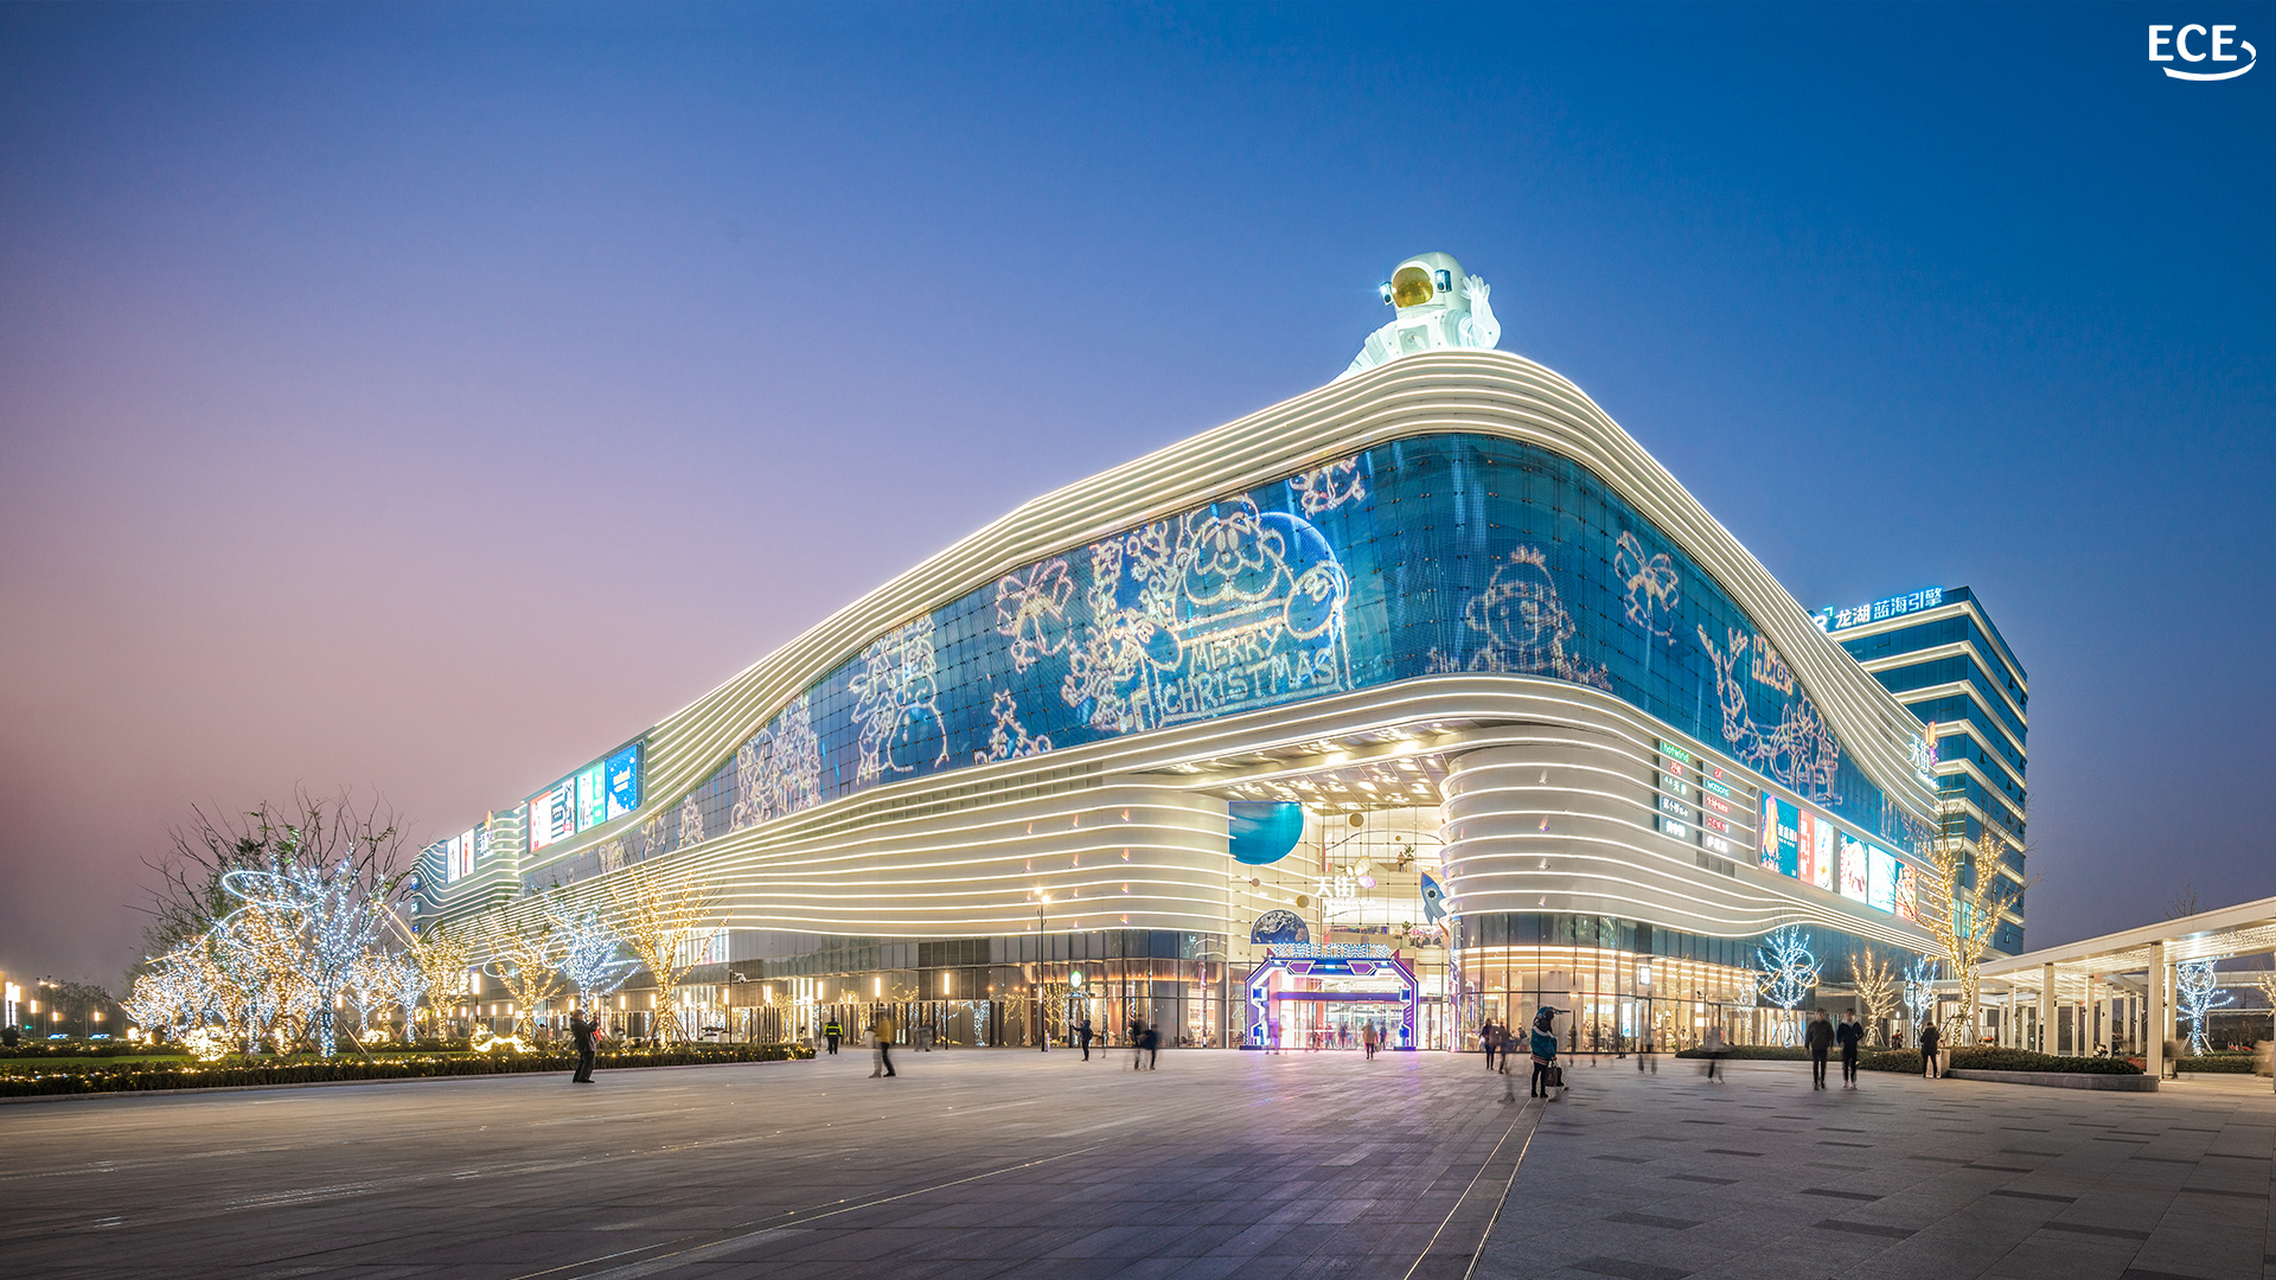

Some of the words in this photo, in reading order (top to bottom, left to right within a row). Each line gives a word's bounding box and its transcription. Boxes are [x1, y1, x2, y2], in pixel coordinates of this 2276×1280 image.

[1835, 603, 1871, 629] 龙湖
[1873, 588, 1943, 619] 蓝海引擎
[1189, 622, 1284, 674] MERRY
[1163, 647, 1334, 713] CHRISTMAS
[1312, 875, 1357, 898] 天街
